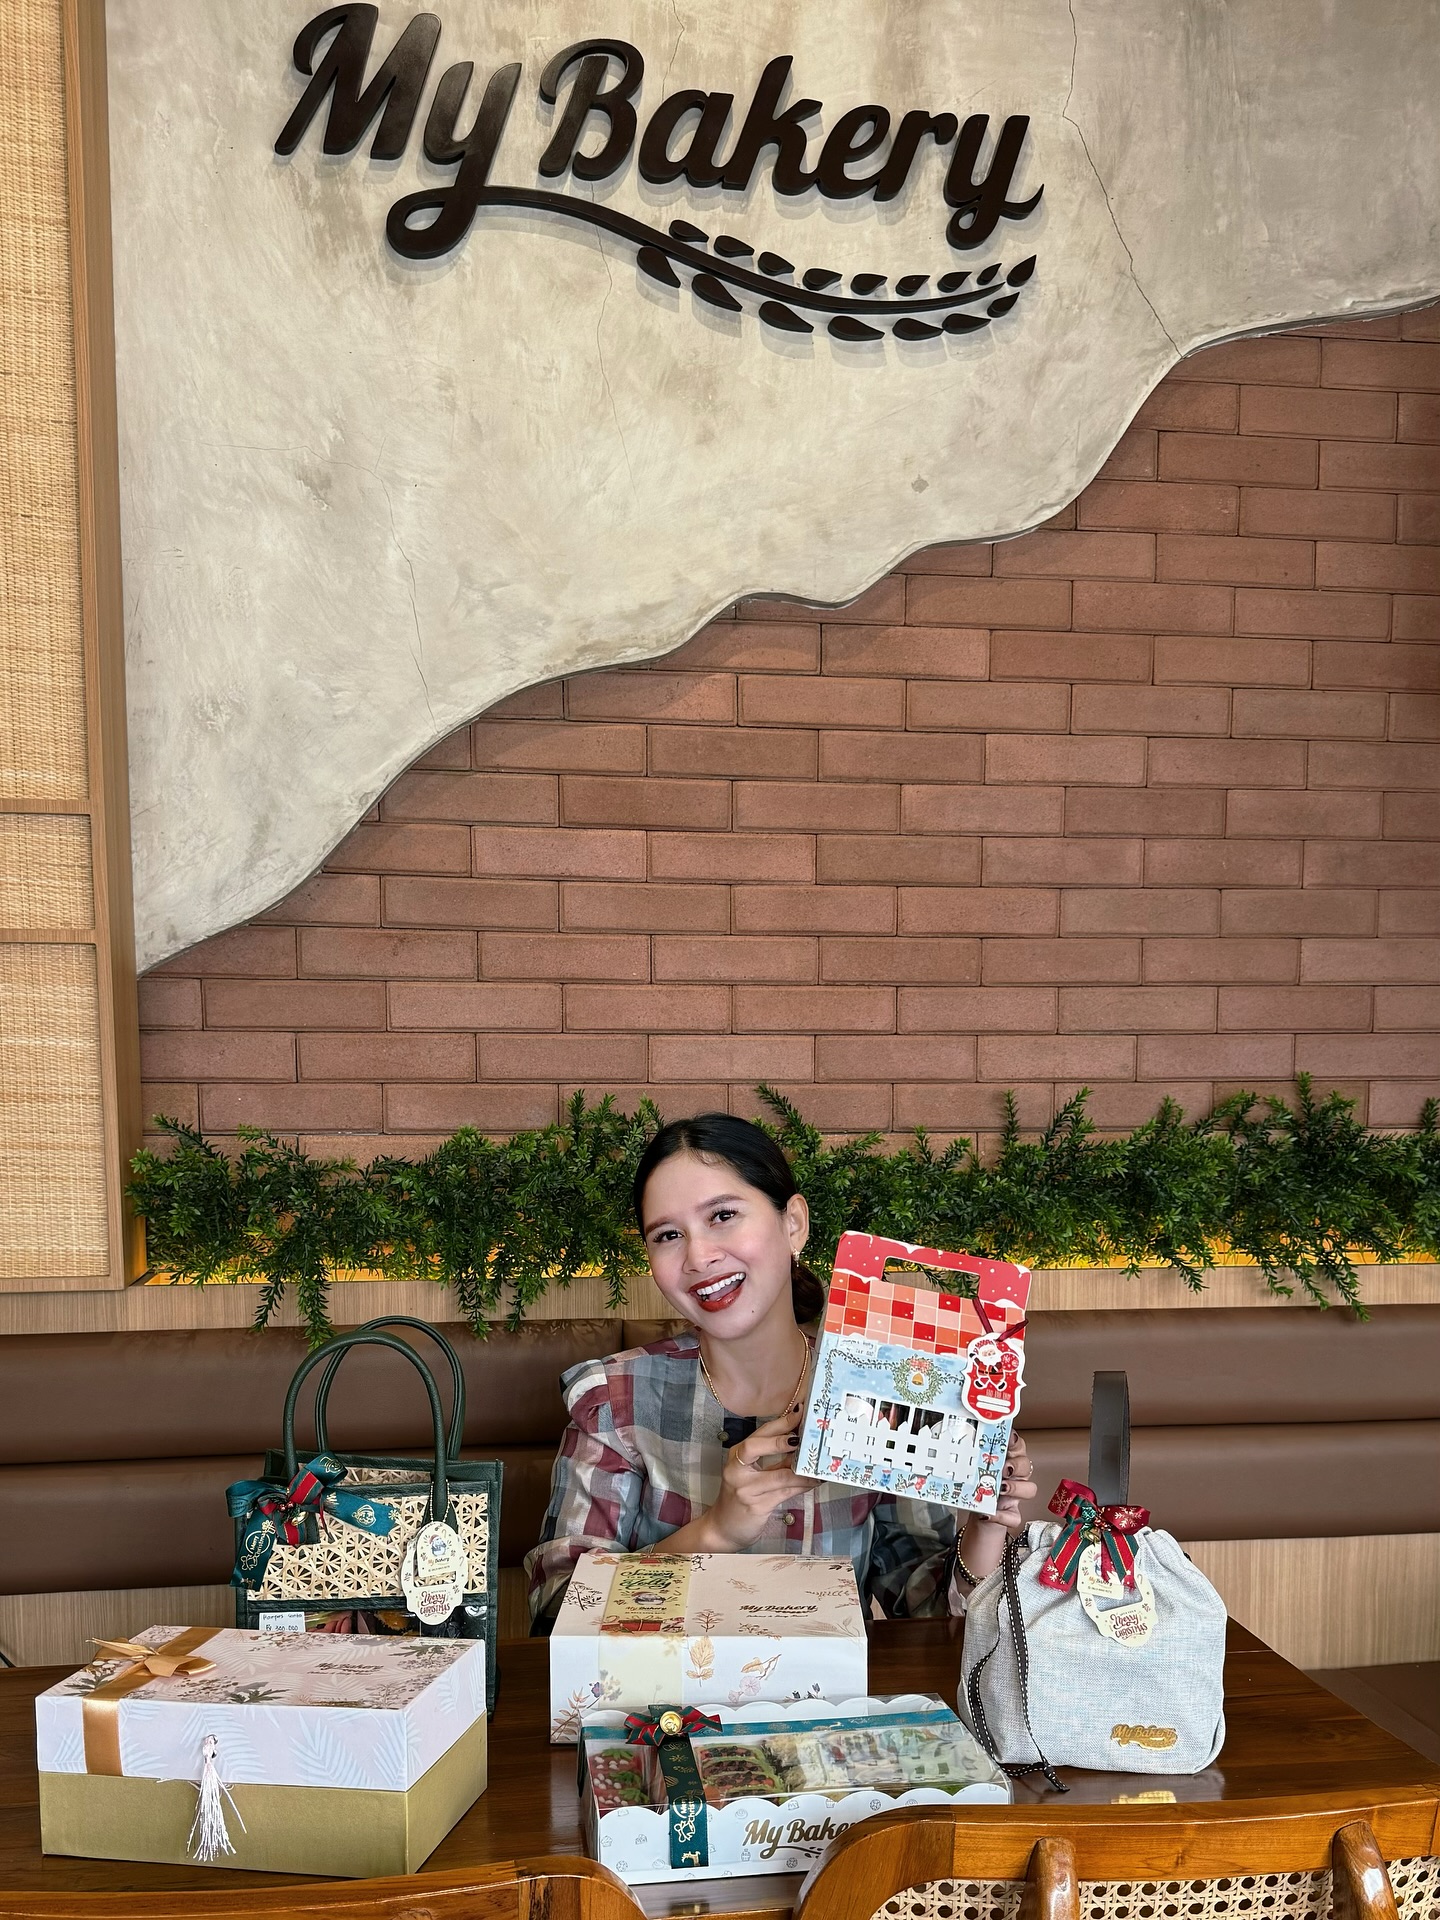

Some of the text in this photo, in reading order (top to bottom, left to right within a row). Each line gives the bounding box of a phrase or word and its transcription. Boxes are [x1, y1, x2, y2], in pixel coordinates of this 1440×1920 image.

[274, 3, 1045, 259] My Bakery
[421, 1591, 447, 1606] Merry
[420, 1603, 450, 1615] CHRISTMAS
[1110, 1613, 1139, 1629] Merry
[1115, 1623, 1148, 1638] CHRISTMAS
[742, 1816, 856, 1859] My Bake
